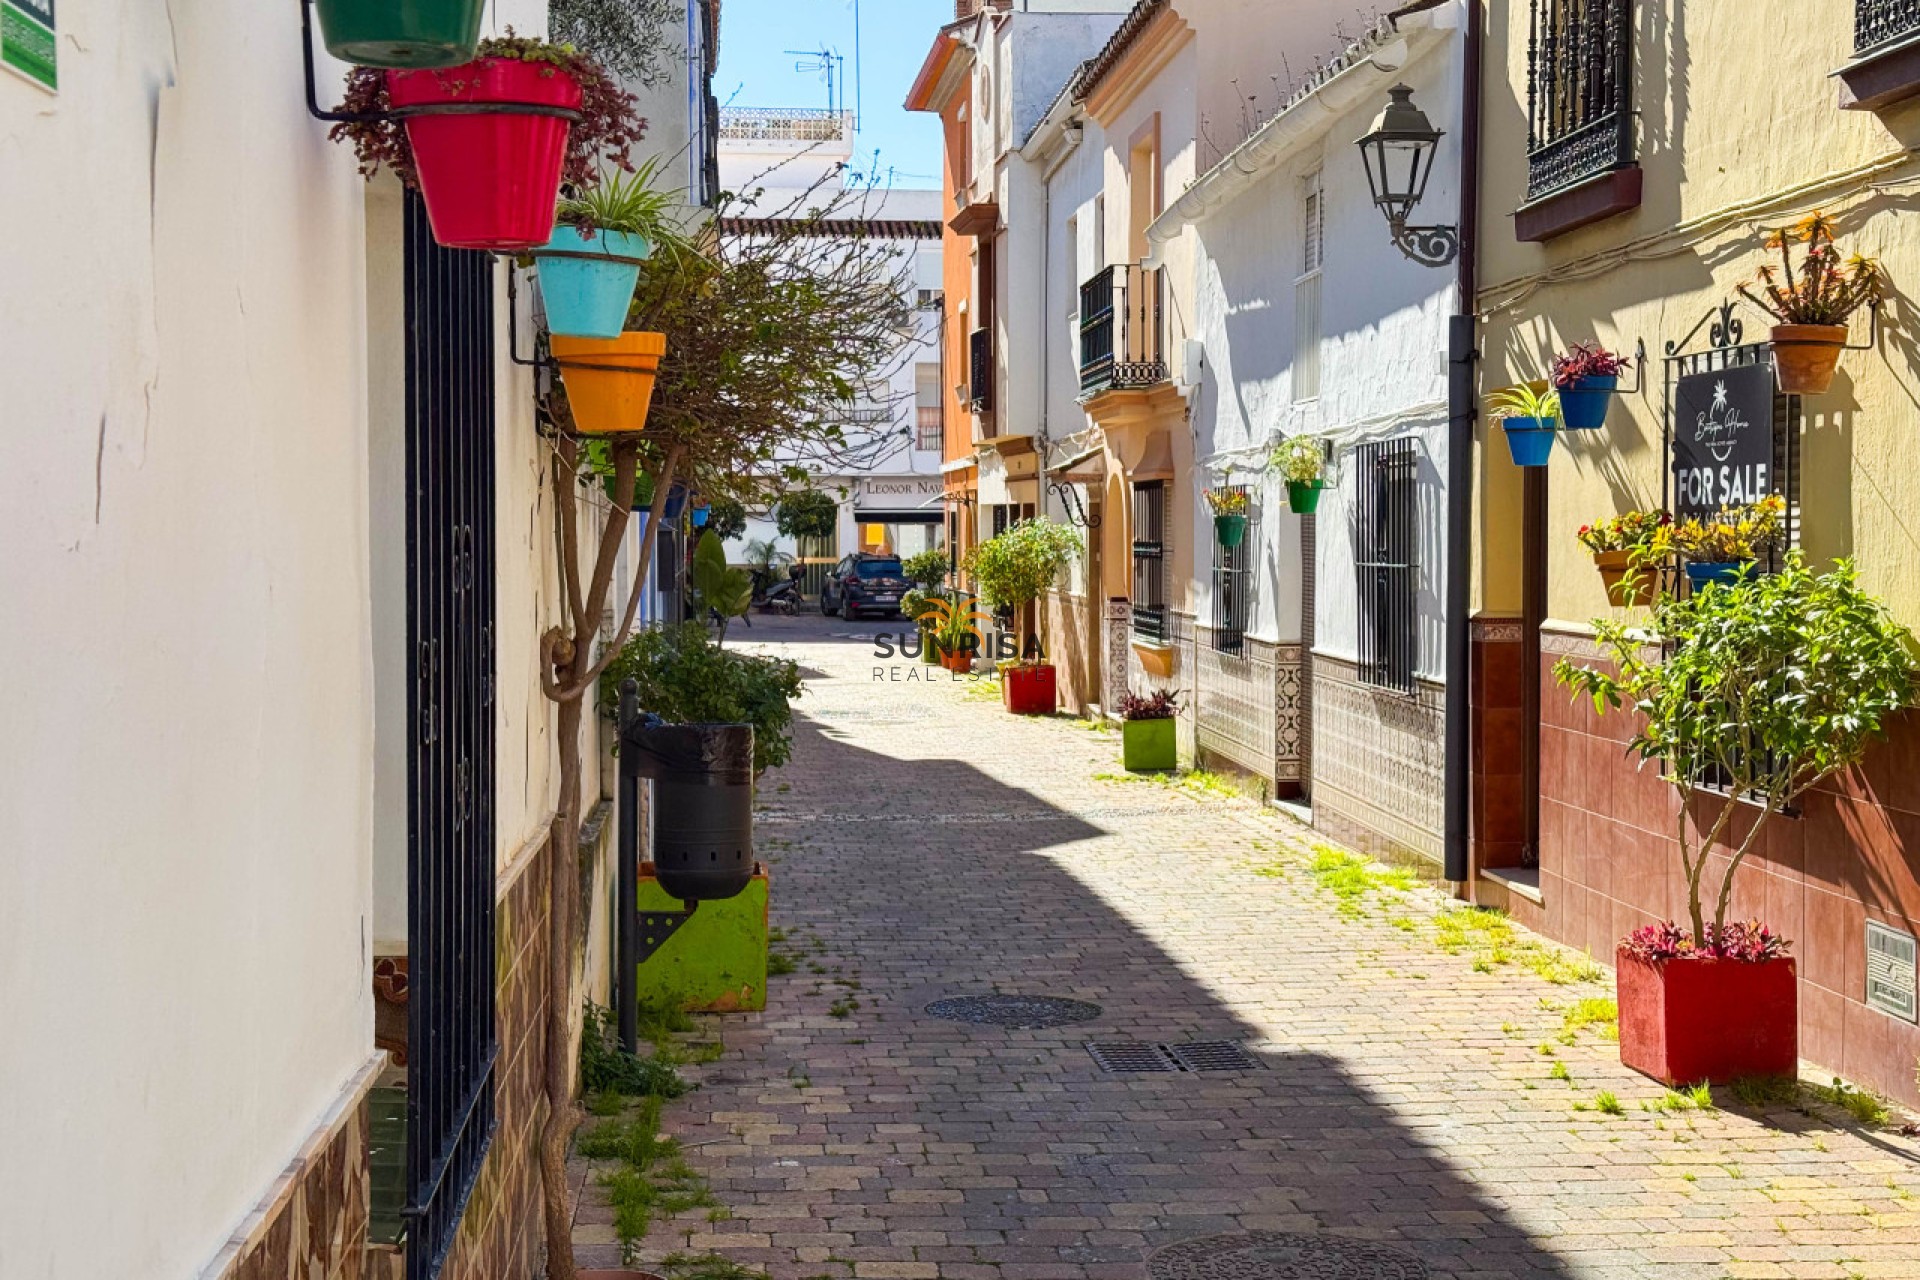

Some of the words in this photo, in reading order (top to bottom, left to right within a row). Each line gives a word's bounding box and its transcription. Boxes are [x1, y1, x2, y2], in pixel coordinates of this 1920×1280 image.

[866, 481, 913, 495] LEONOR
[1677, 466, 1714, 506] FOR
[1718, 463, 1767, 505] SALE
